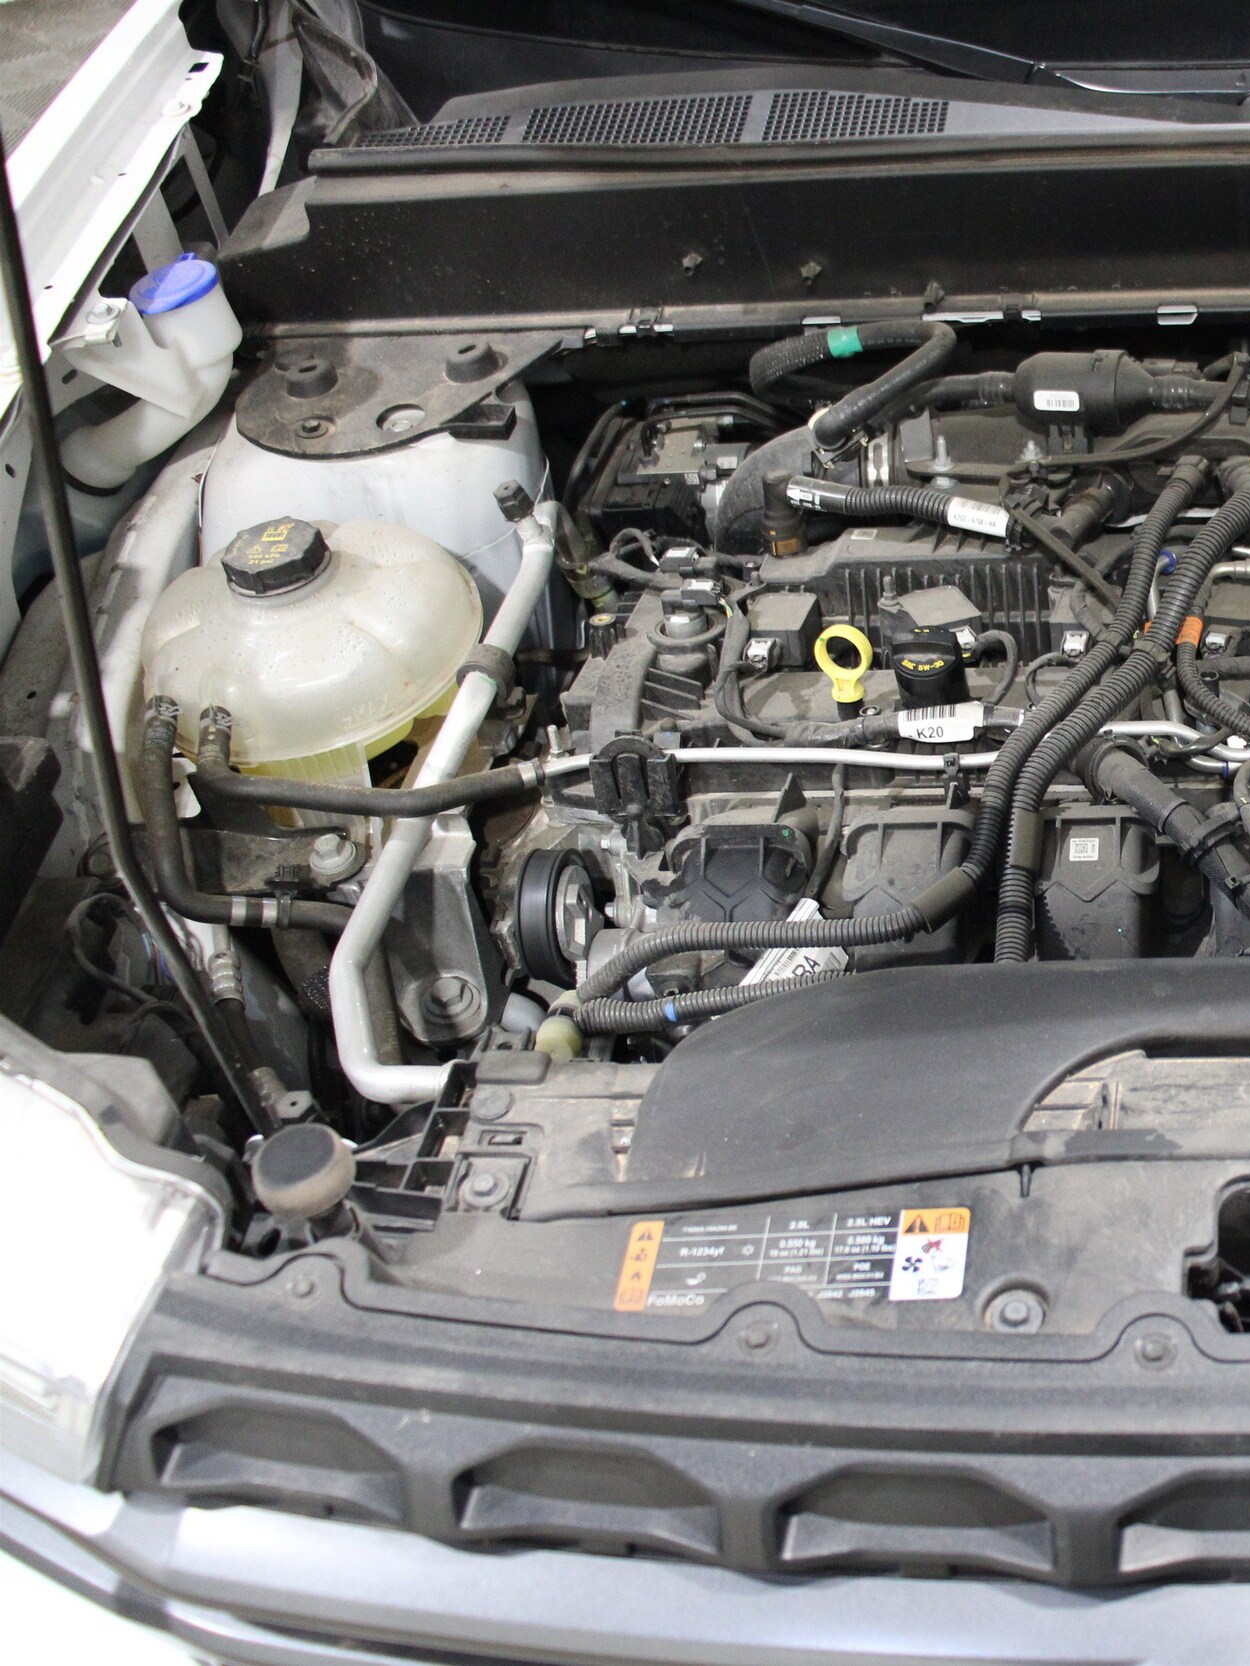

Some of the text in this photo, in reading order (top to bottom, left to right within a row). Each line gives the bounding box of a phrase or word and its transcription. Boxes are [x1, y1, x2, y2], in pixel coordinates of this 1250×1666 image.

[902, 659, 944, 671] SAE 5W-30
[917, 726, 943, 739] K20
[868, 1216, 892, 1226] HEV
[679, 1246, 726, 1257] R-1234yf
[648, 1292, 705, 1307] FoMoCo
